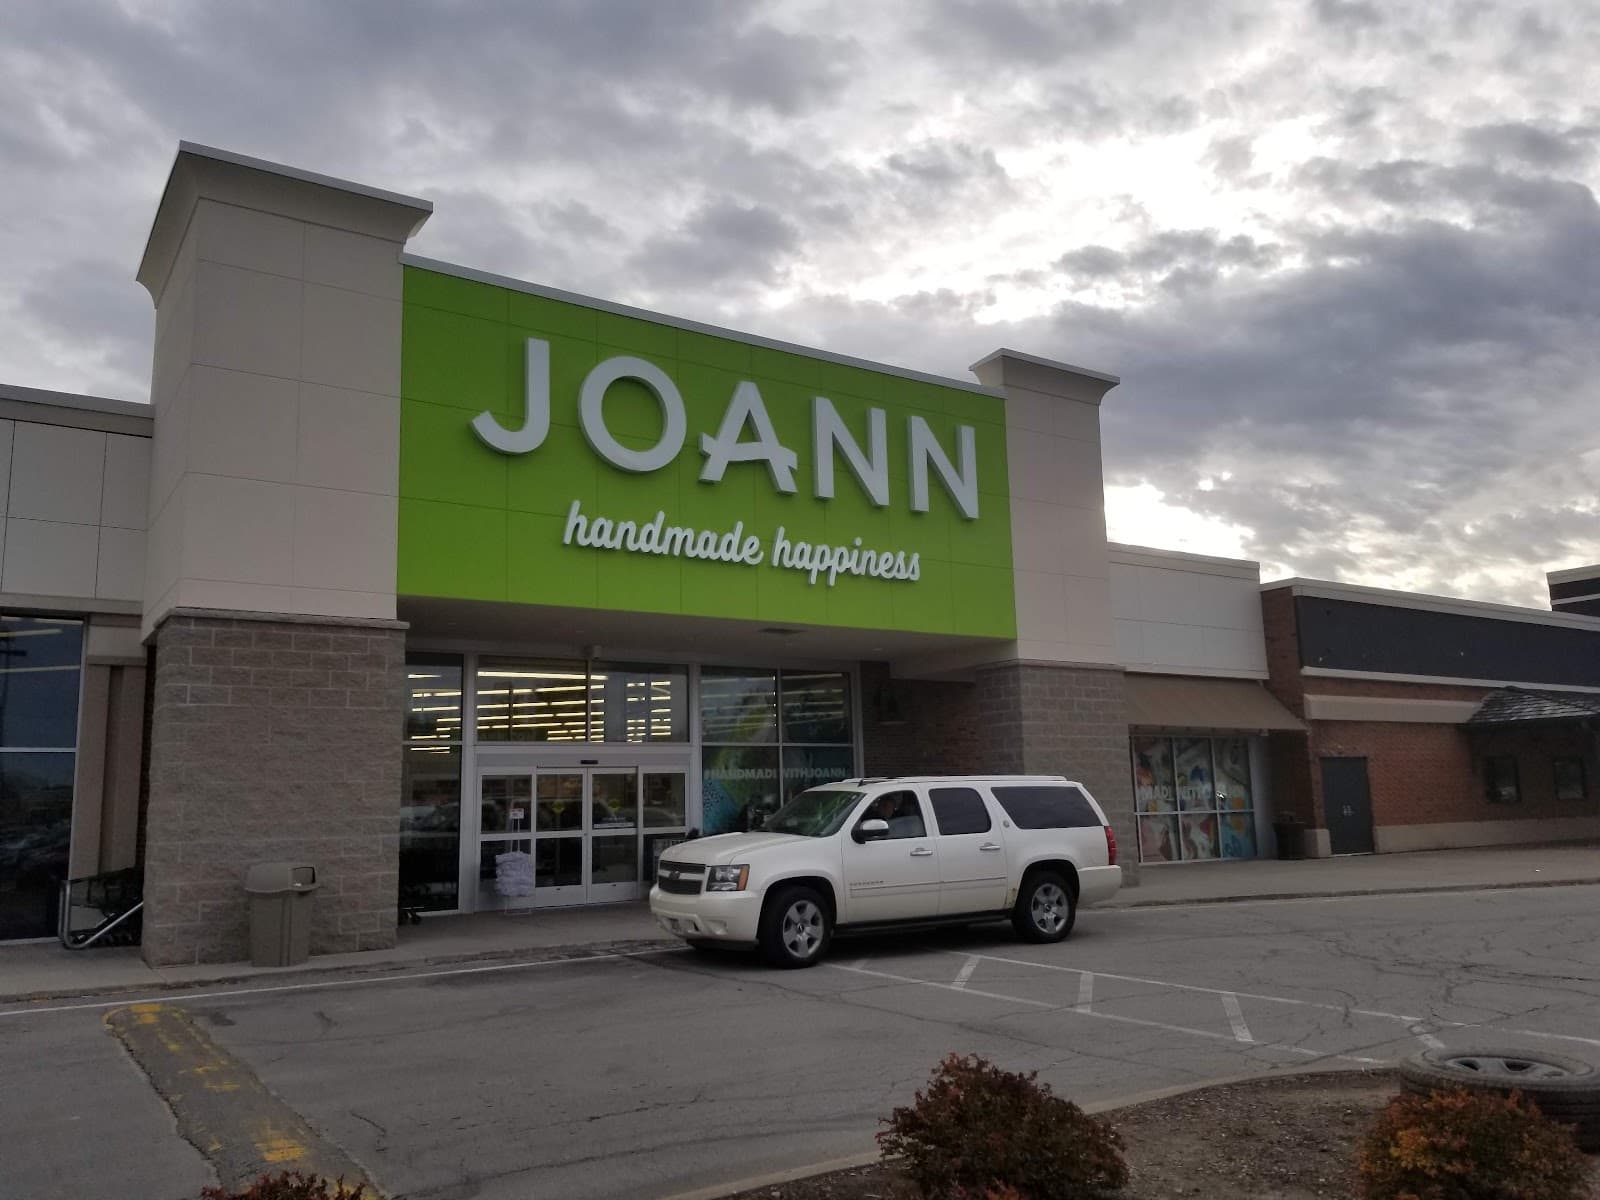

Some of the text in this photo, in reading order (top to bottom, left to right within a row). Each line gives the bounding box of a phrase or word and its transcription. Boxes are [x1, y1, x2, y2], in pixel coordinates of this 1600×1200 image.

[471, 338, 980, 520] JOANN
[563, 500, 922, 587] handmade happiness
